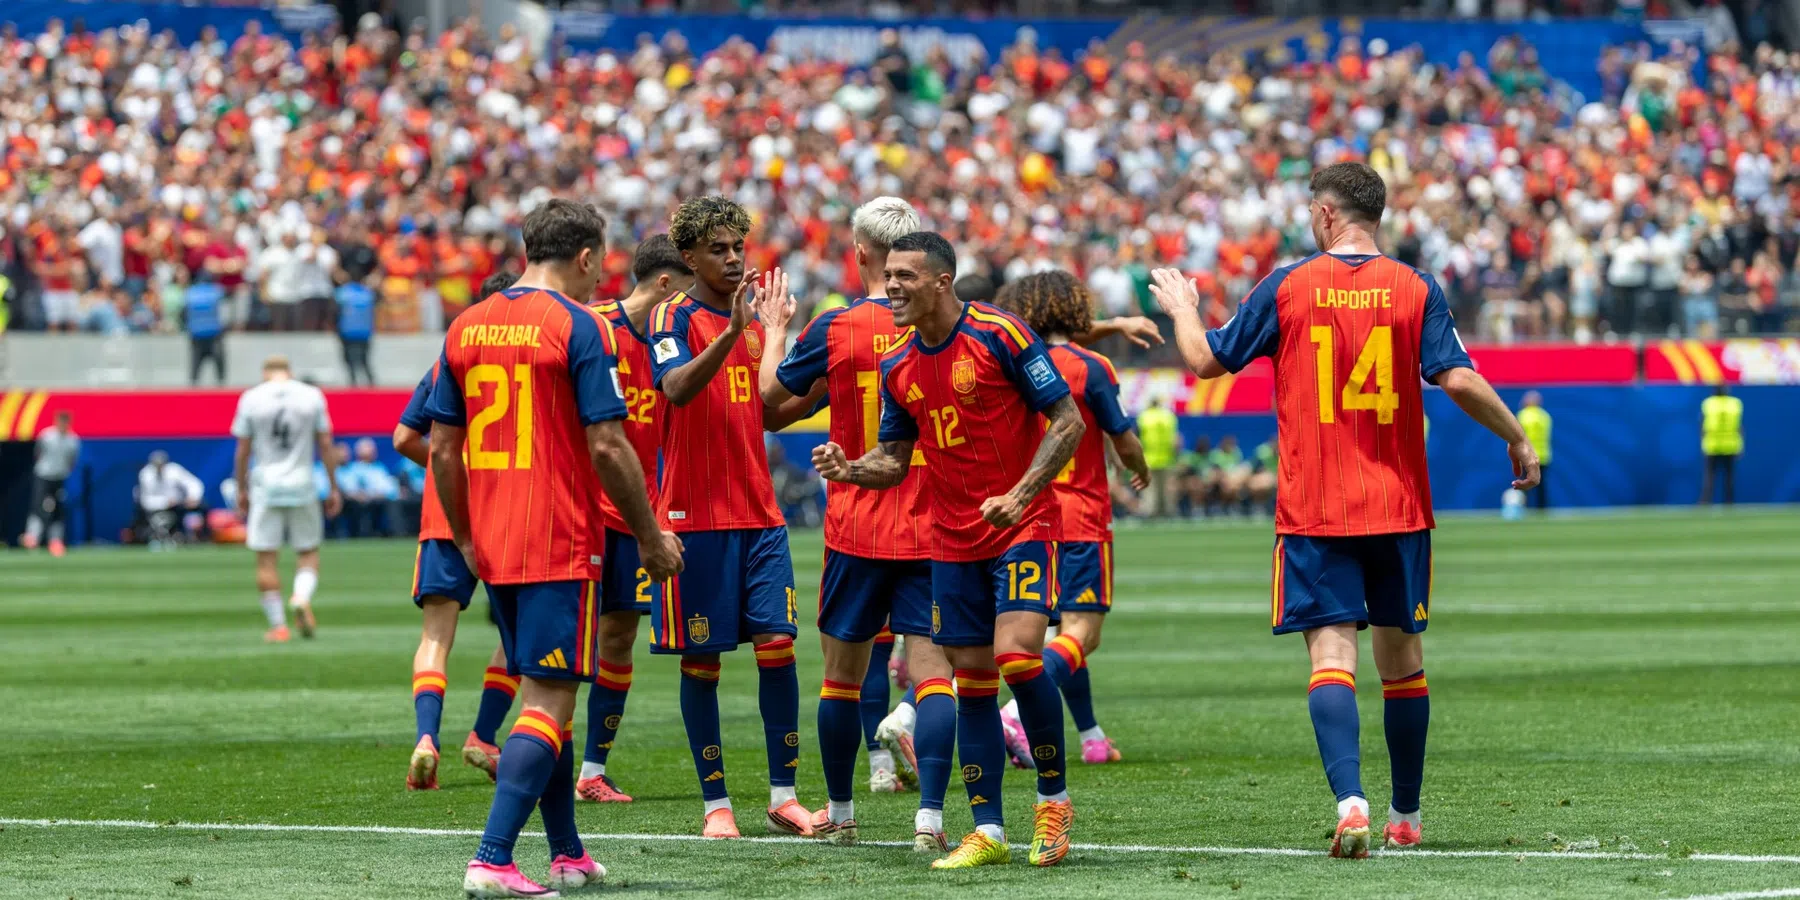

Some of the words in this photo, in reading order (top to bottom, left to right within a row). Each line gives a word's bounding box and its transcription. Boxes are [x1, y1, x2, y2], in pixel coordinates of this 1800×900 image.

[1315, 287, 1392, 310] LAPORTE
[460, 324, 541, 348] OYARZABAL
[873, 333, 901, 354] OL
[726, 365, 751, 403] 19
[1310, 325, 1400, 425] 14
[465, 363, 533, 470] 21
[624, 385, 657, 424] 22
[929, 404, 966, 449] 12
[1007, 560, 1041, 601] 12
